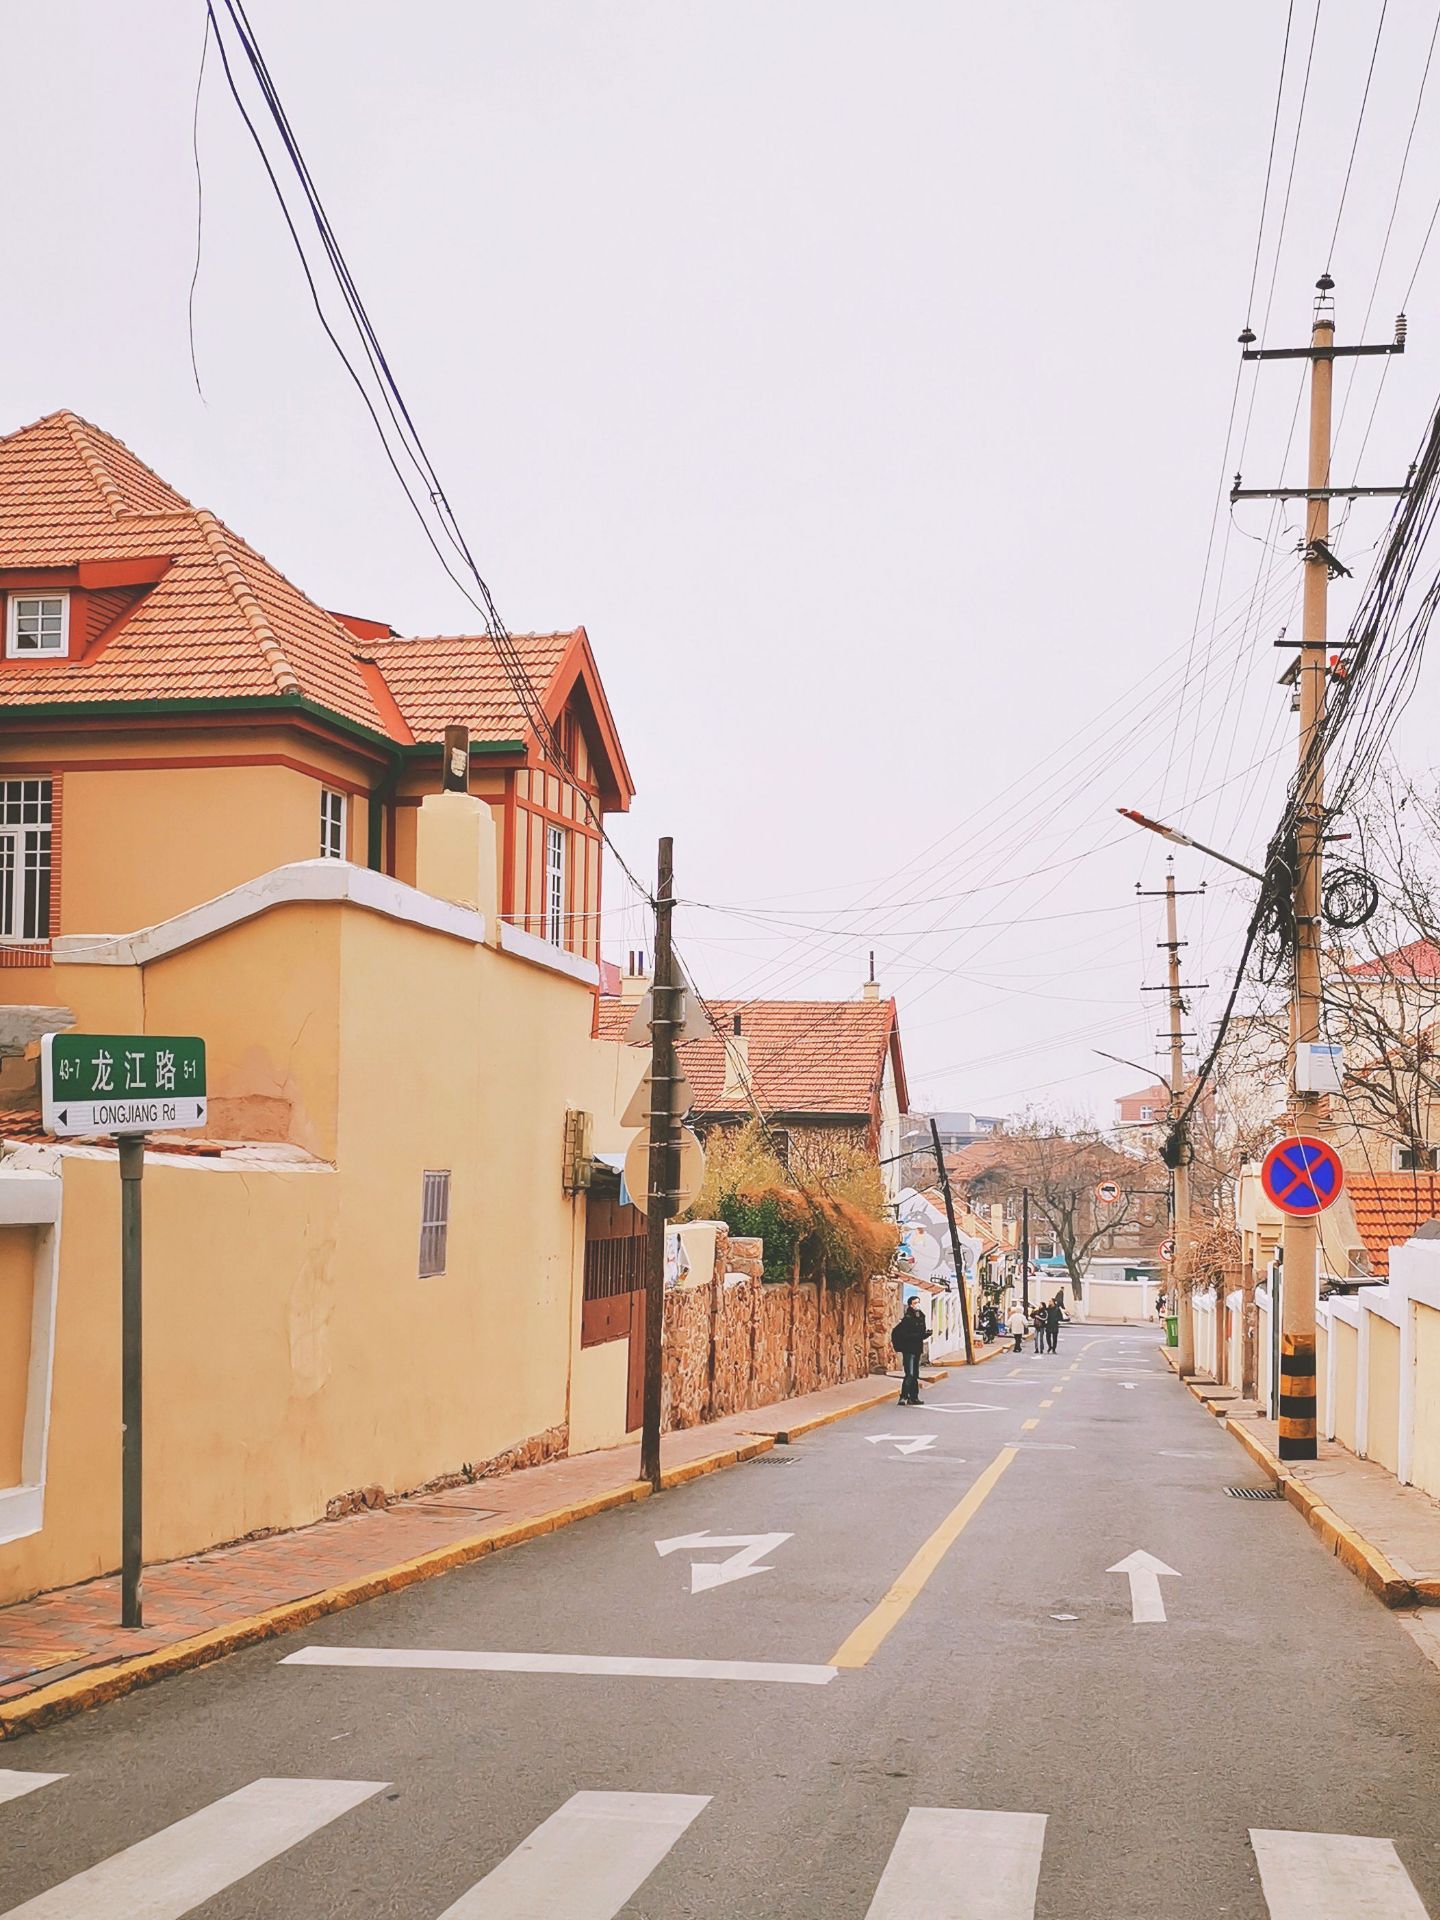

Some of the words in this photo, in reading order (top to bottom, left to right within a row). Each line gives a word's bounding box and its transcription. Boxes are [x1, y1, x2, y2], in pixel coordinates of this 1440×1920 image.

[59, 1058, 81, 1080] 43-7
[91, 1049, 177, 1092] 龙江路
[183, 1059, 196, 1079] 5-1
[92, 1105, 158, 1125] LONGJIANG
[162, 1103, 176, 1121] Rd
